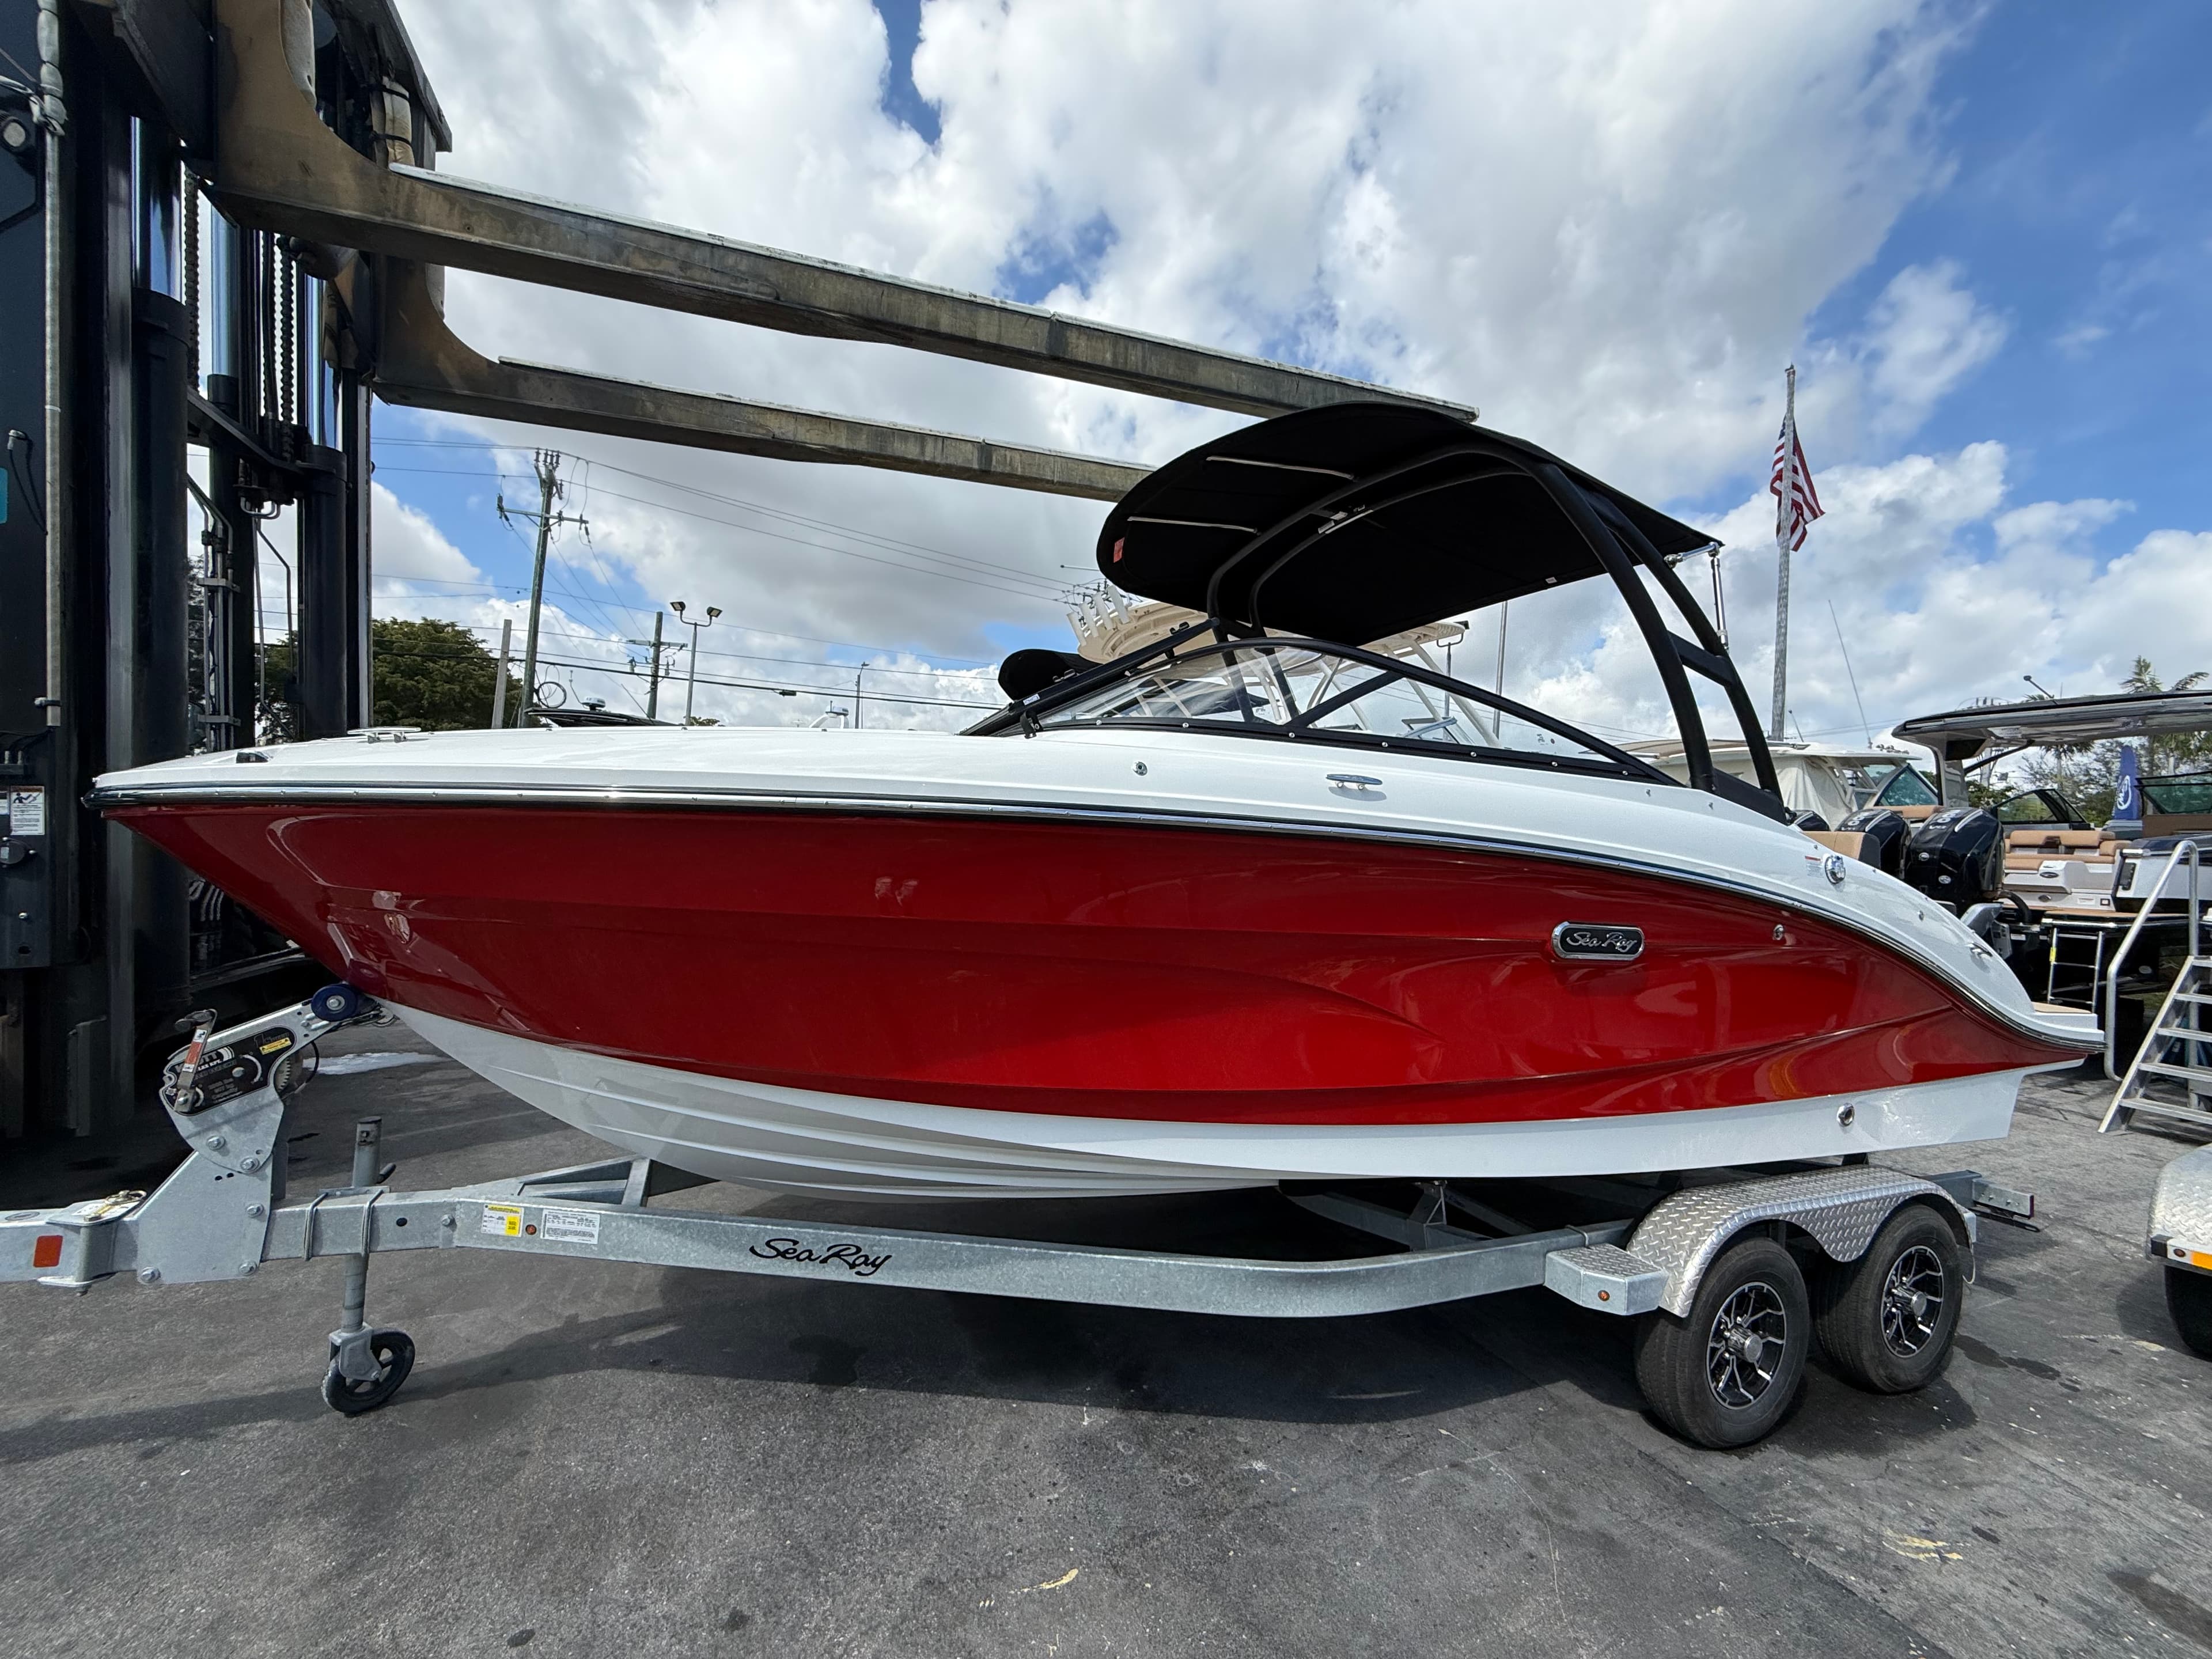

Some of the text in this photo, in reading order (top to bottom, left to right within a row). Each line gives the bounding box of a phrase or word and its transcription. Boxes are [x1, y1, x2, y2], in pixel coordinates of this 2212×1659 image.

[1566, 931, 1638, 953] Sea Ray
[749, 1238, 892, 1276] Sea Ray
